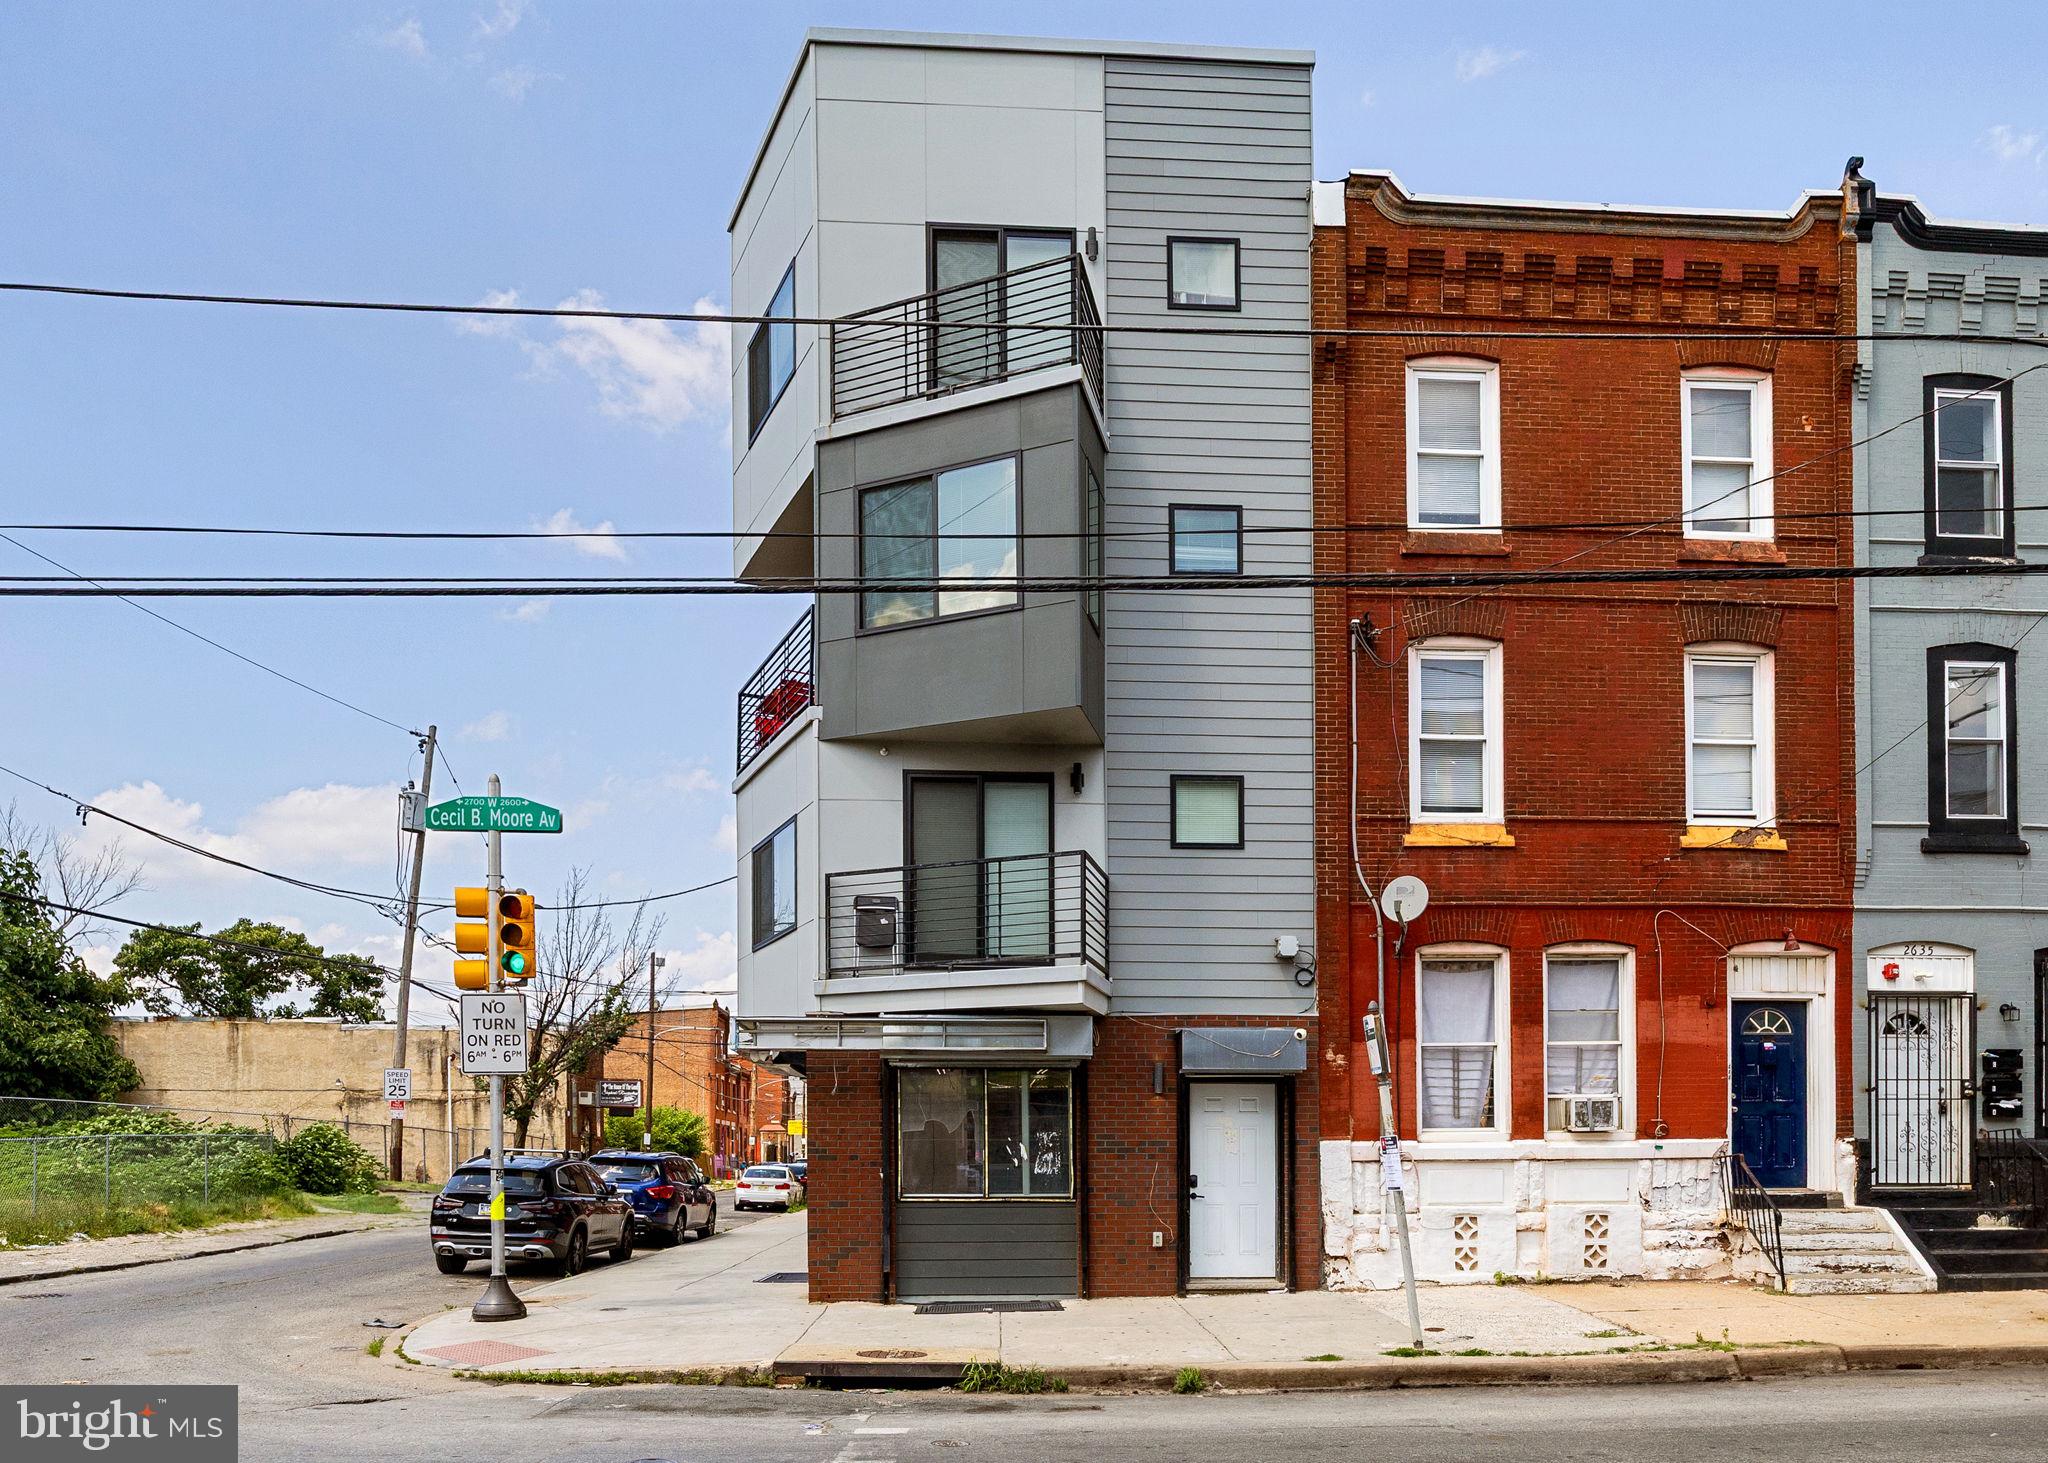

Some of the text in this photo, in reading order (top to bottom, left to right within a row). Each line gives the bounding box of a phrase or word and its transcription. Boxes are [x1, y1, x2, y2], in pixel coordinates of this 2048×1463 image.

[487, 798, 497, 808] W
[430, 808, 556, 827] Cecil B. Moore Av
[1904, 944, 1933, 956] 2635
[482, 1002, 505, 1014] NO
[472, 1018, 515, 1030] TURN
[467, 1034, 521, 1046] ON RED
[467, 1051, 486, 1062] 6AM
[503, 1051, 522, 1062] 6PM
[388, 1085, 407, 1097] 25
